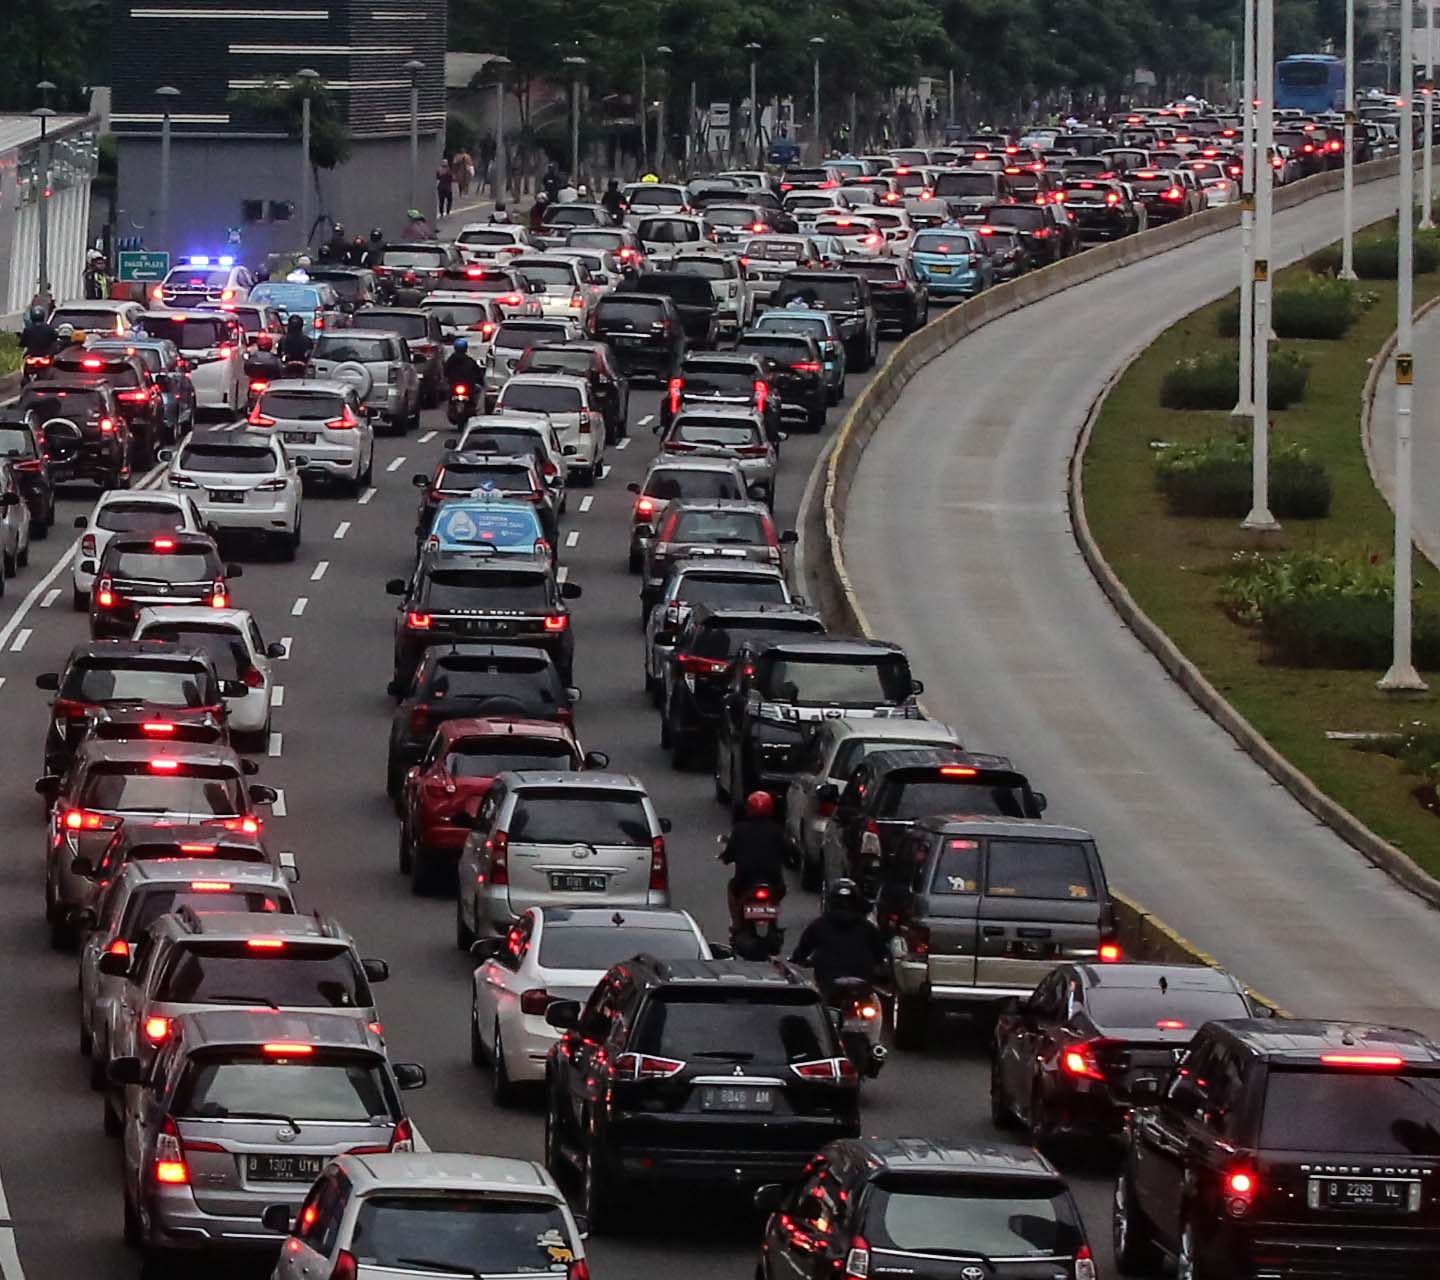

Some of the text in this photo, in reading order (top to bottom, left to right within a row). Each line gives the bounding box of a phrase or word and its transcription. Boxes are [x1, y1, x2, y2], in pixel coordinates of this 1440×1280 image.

[1300, 1164, 1434, 1176] RANGE ROVER
[1329, 1182, 1338, 1197] B
[1346, 1183, 1374, 1197] 2299
